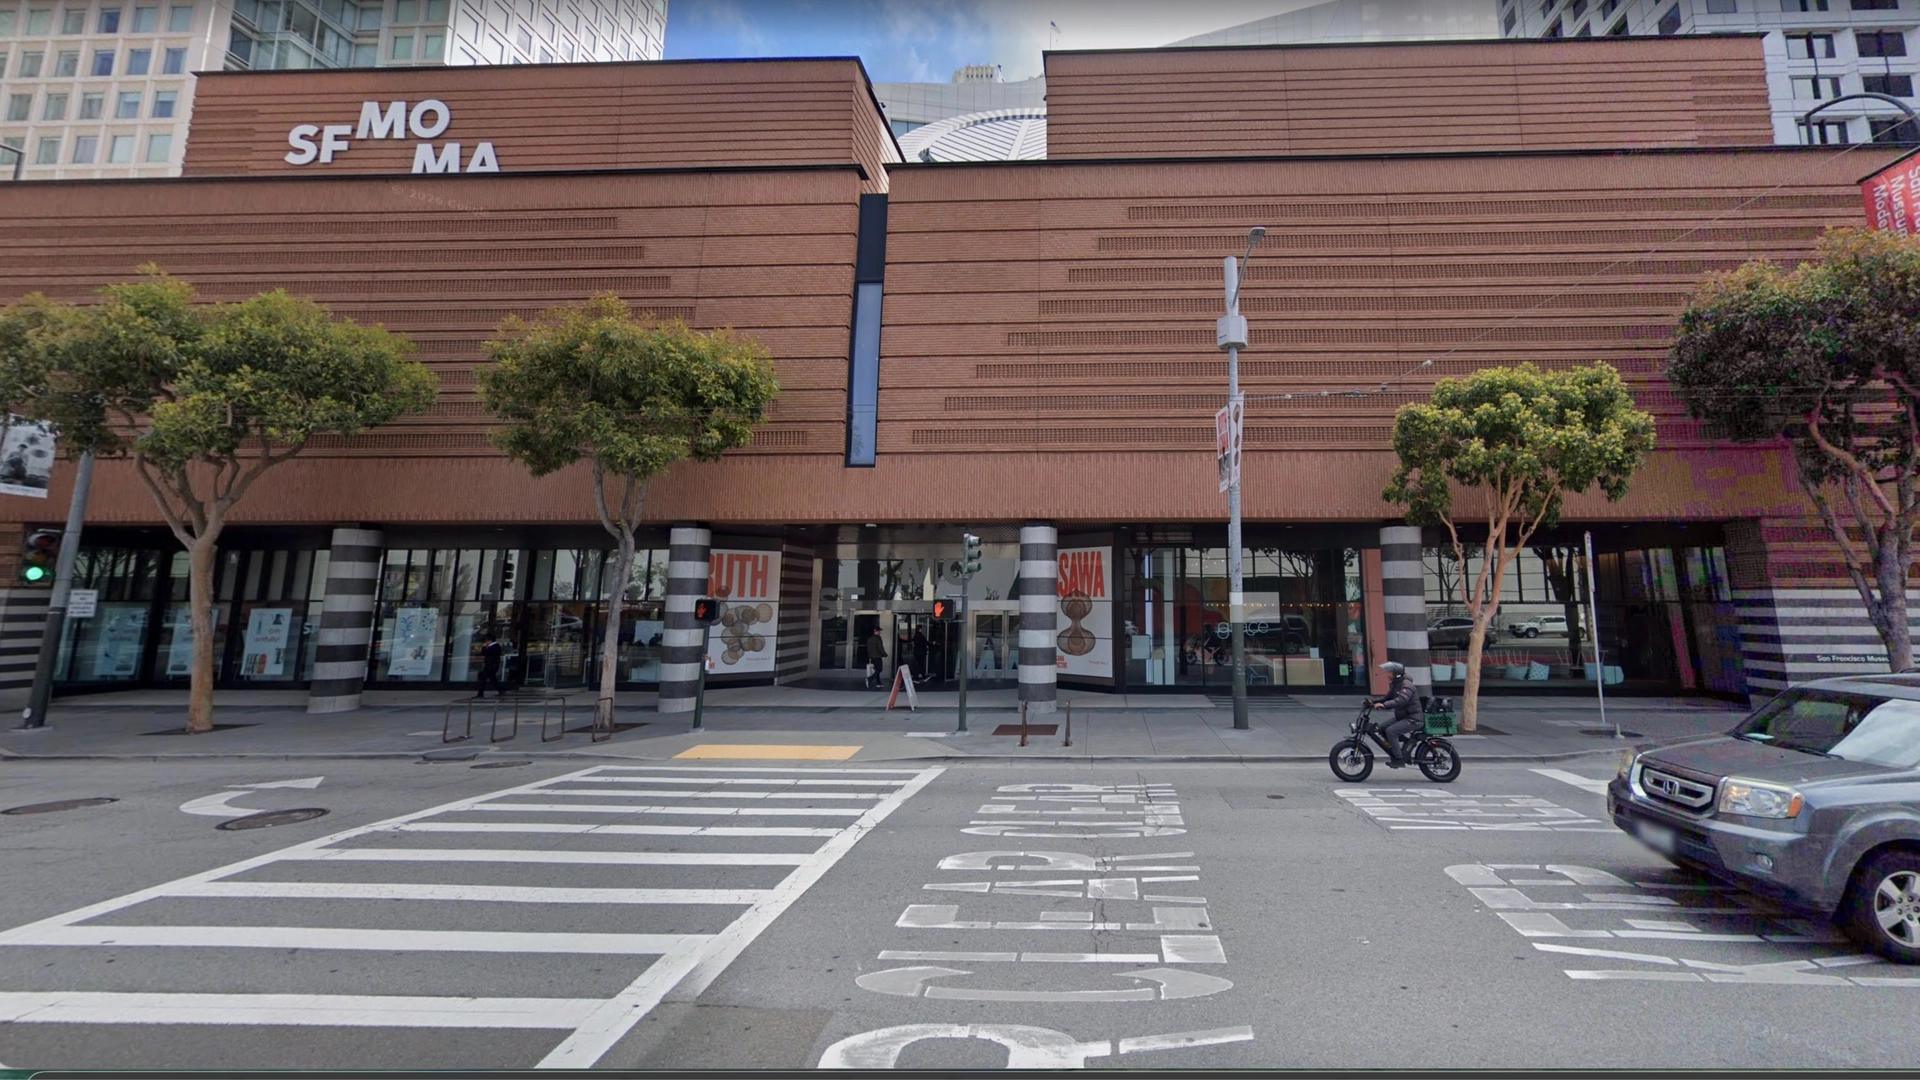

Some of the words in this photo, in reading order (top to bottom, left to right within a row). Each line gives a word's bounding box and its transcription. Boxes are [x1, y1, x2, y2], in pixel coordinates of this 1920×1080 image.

[283, 123, 353, 166] SF
[355, 98, 451, 139] MO
[411, 142, 500, 174] MA
[1056, 550, 1106, 598] SAWA
[1816, 654, 1832, 663] San
[1832, 655, 1866, 663] Francisco
